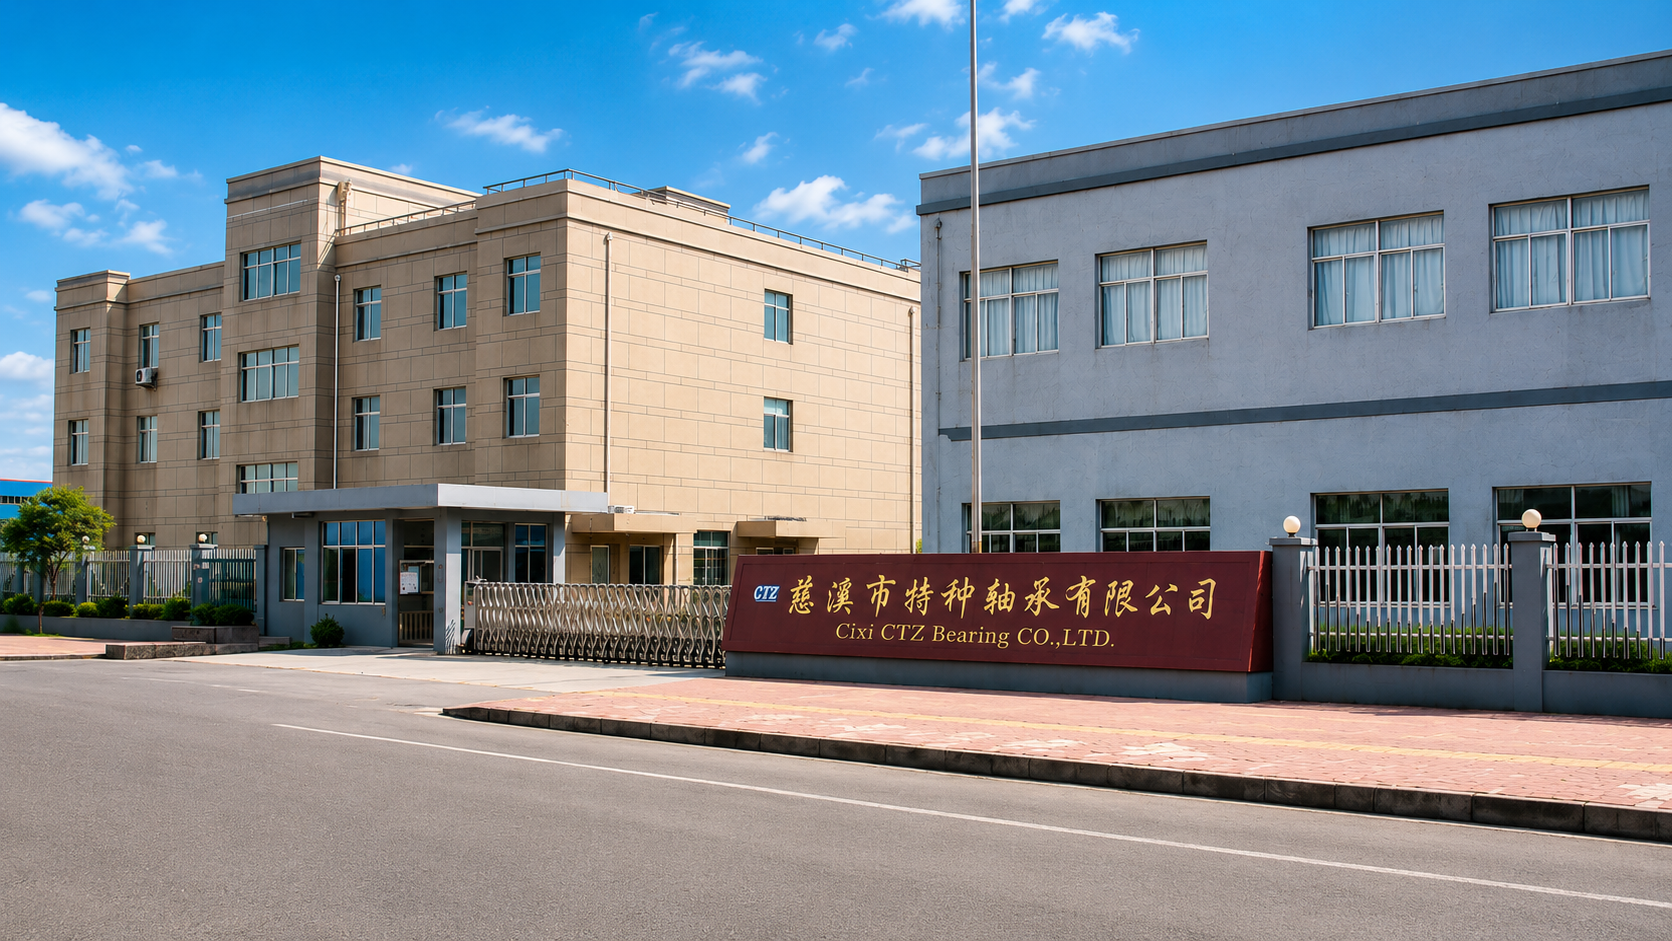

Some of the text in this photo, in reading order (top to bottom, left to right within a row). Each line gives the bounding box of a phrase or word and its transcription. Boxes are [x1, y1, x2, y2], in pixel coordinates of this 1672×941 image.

[753, 585, 780, 600] CTZ
[788, 574, 1217, 620] 慈溪市特种轴承有限公司
[835, 622, 874, 640] Cixi
[880, 623, 926, 642] CTZ
[931, 625, 1010, 649] Bearing
